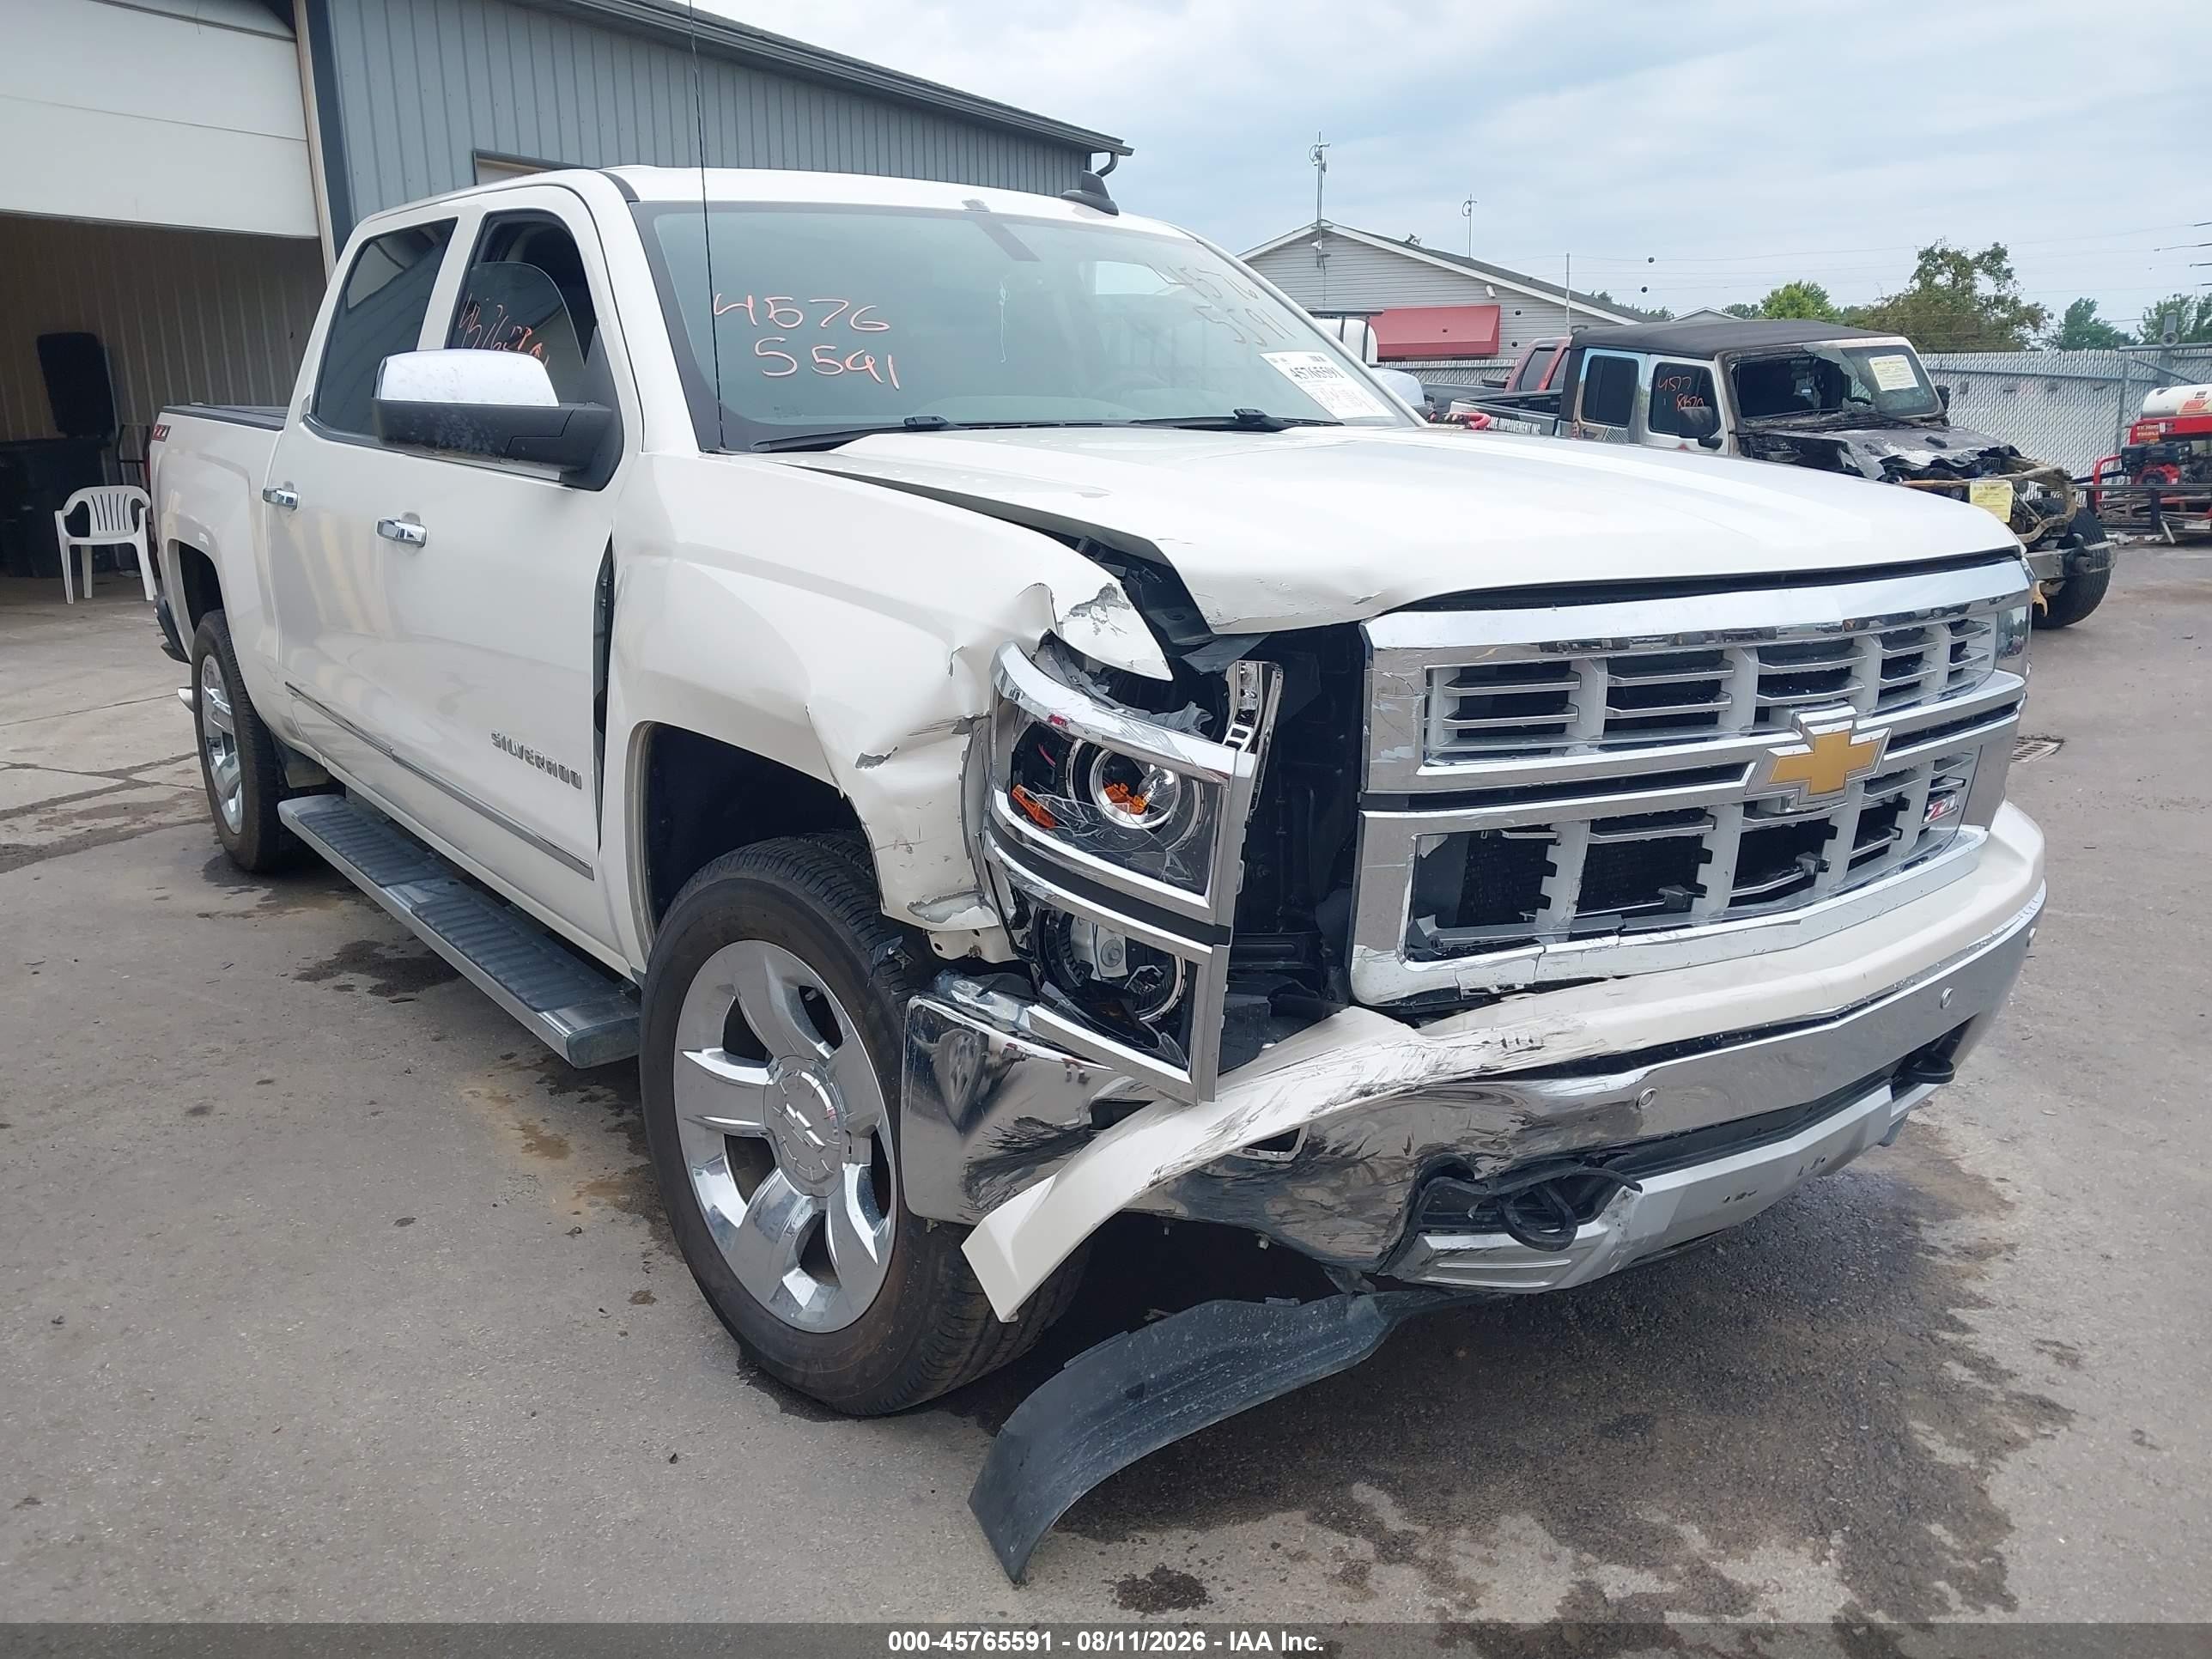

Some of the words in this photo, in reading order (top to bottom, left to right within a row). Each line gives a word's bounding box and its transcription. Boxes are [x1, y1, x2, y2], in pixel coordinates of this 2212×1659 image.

[714, 293, 891, 331] 4576
[755, 337, 901, 391] 5591
[1289, 367, 1346, 380] 45765591
[490, 732, 582, 791] SILVERADO
